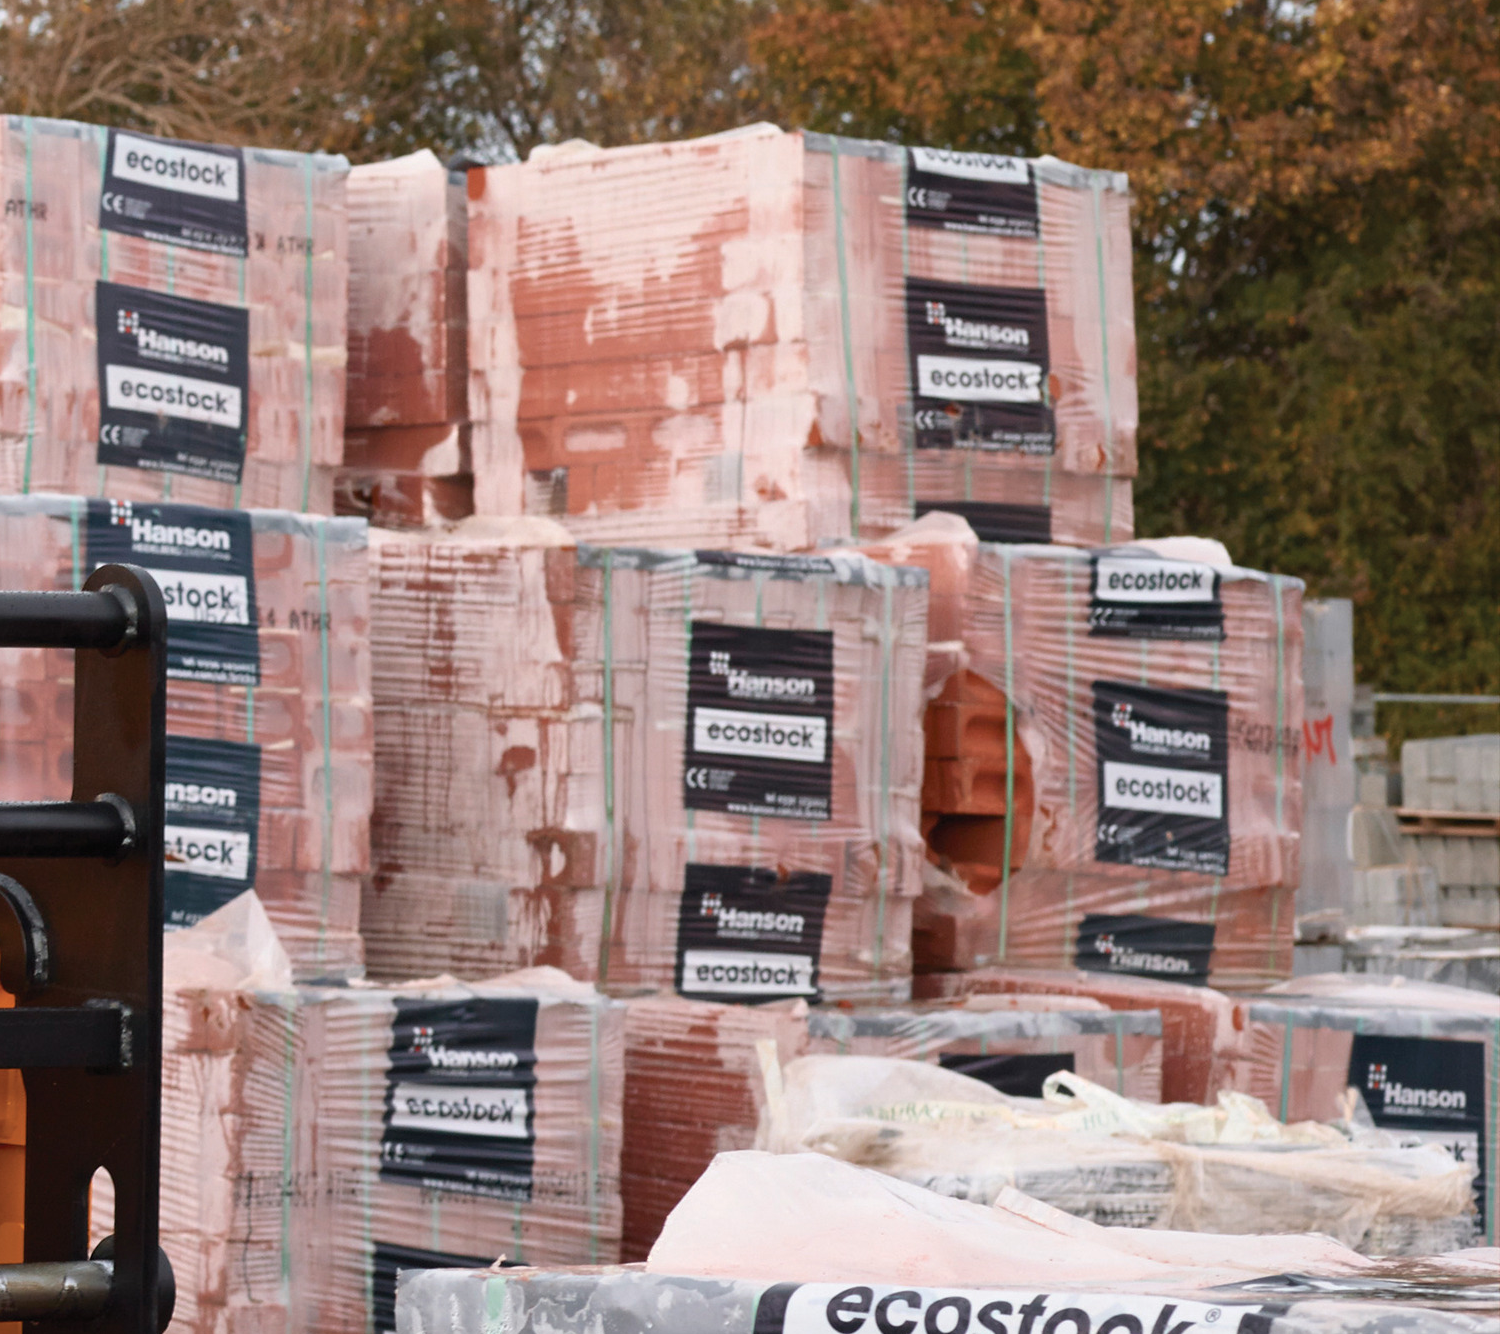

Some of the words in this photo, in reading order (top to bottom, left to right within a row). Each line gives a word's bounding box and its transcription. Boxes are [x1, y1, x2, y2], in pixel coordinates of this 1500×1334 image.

[127, 149, 227, 187] ecostock
[945, 317, 1030, 345] Hanson
[138, 327, 229, 364] Hanson
[931, 367, 1030, 389] ecostock
[120, 380, 228, 414] ecostock
[132, 518, 231, 551] Hanson
[1108, 567, 1203, 590] ecostock
[164, 581, 234, 610] stock
[728, 670, 815, 695] Hanson
[707, 722, 814, 748] ecostock
[1131, 721, 1210, 751] Hanson
[165, 783, 237, 806] nson
[1116, 774, 1212, 804] ecostock
[718, 907, 804, 933] Hanson
[697, 961, 798, 986] ecostock
[1384, 1082, 1466, 1109] Hanson
